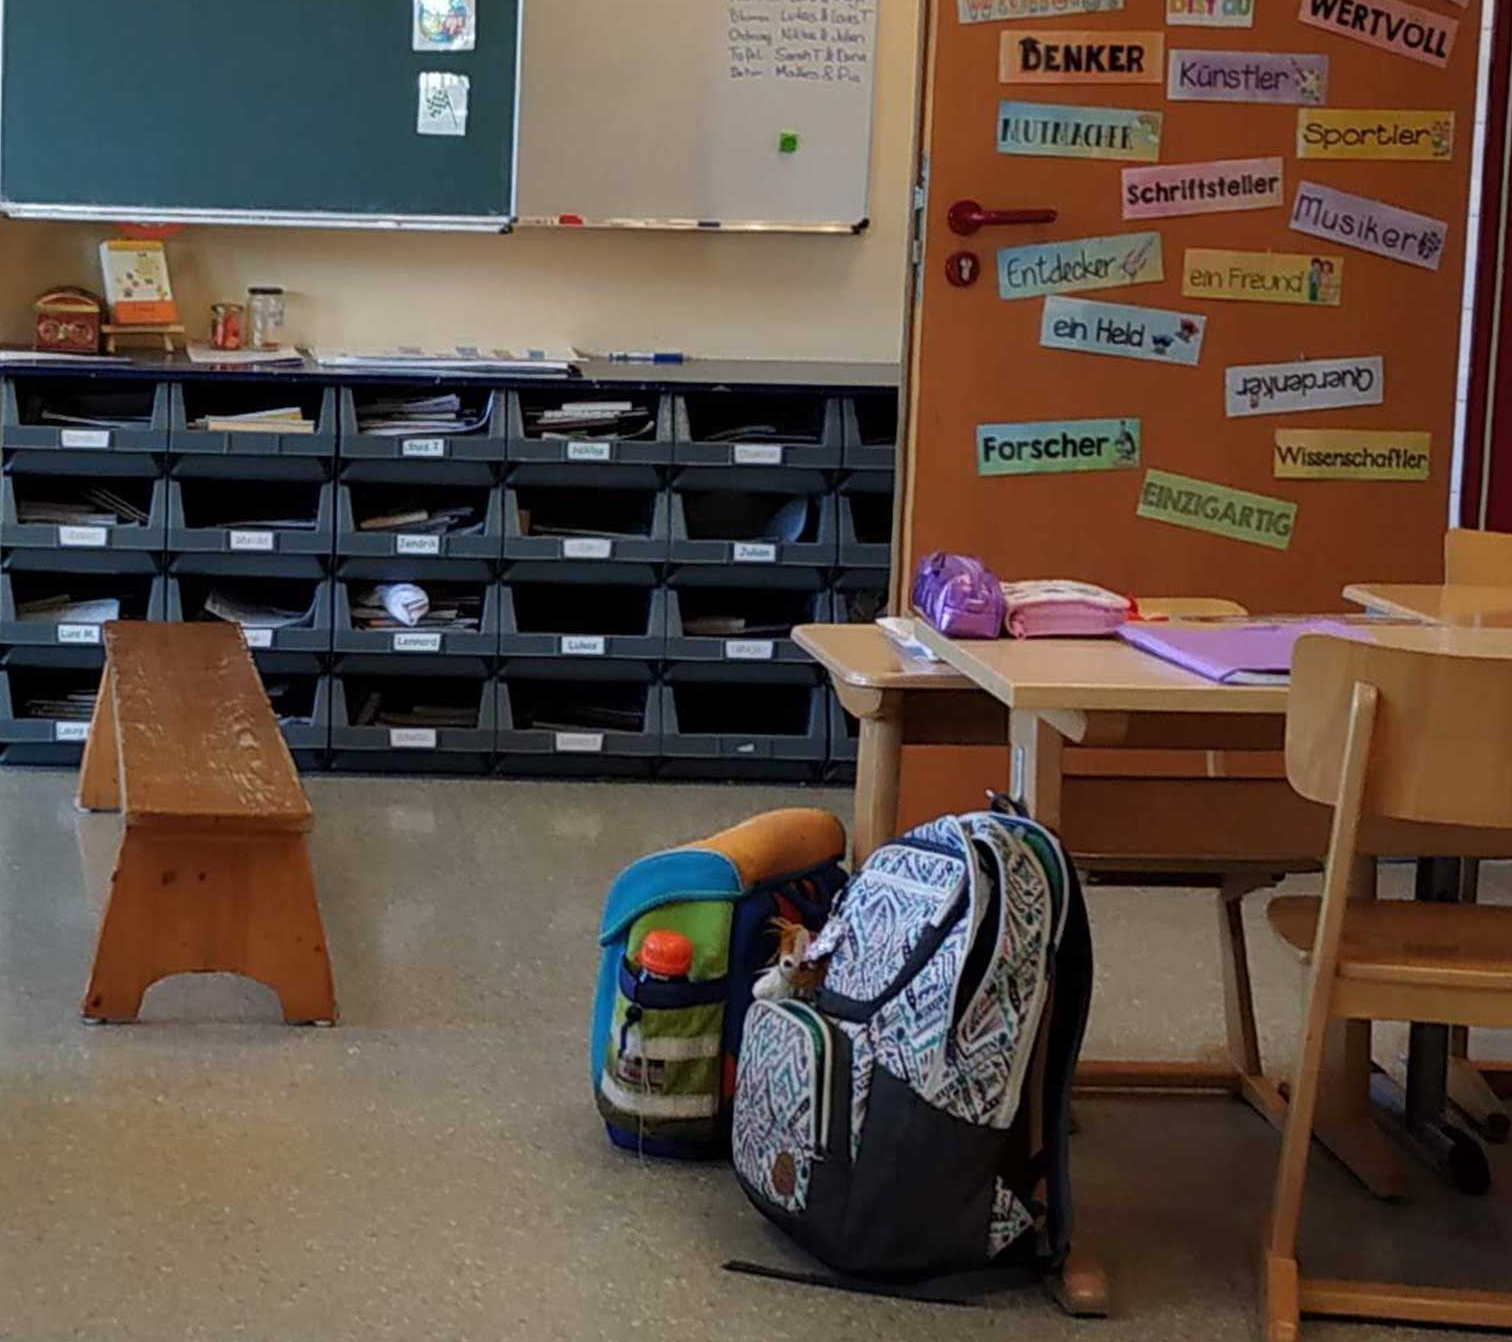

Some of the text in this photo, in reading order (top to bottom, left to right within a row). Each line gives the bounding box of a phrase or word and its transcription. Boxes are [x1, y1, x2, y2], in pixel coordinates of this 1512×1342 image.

[1020, 38, 1145, 74] DENKER
[1179, 59, 1289, 92] Künstler
[1001, 116, 1135, 152] MUTMACHER
[1303, 122, 1431, 154] Sportler
[1127, 173, 1279, 205] Schriftsteller
[1296, 194, 1420, 254] Musiker
[1006, 255, 1117, 290] Entdecker
[1190, 266, 1305, 295] ein Freund
[1053, 316, 1144, 349] ein Held
[1236, 367, 1375, 400] Querdenker
[983, 434, 1109, 463] Forscher
[1275, 444, 1428, 470] Wissenschaftler
[1142, 480, 1293, 537] EINZIGARTIG
